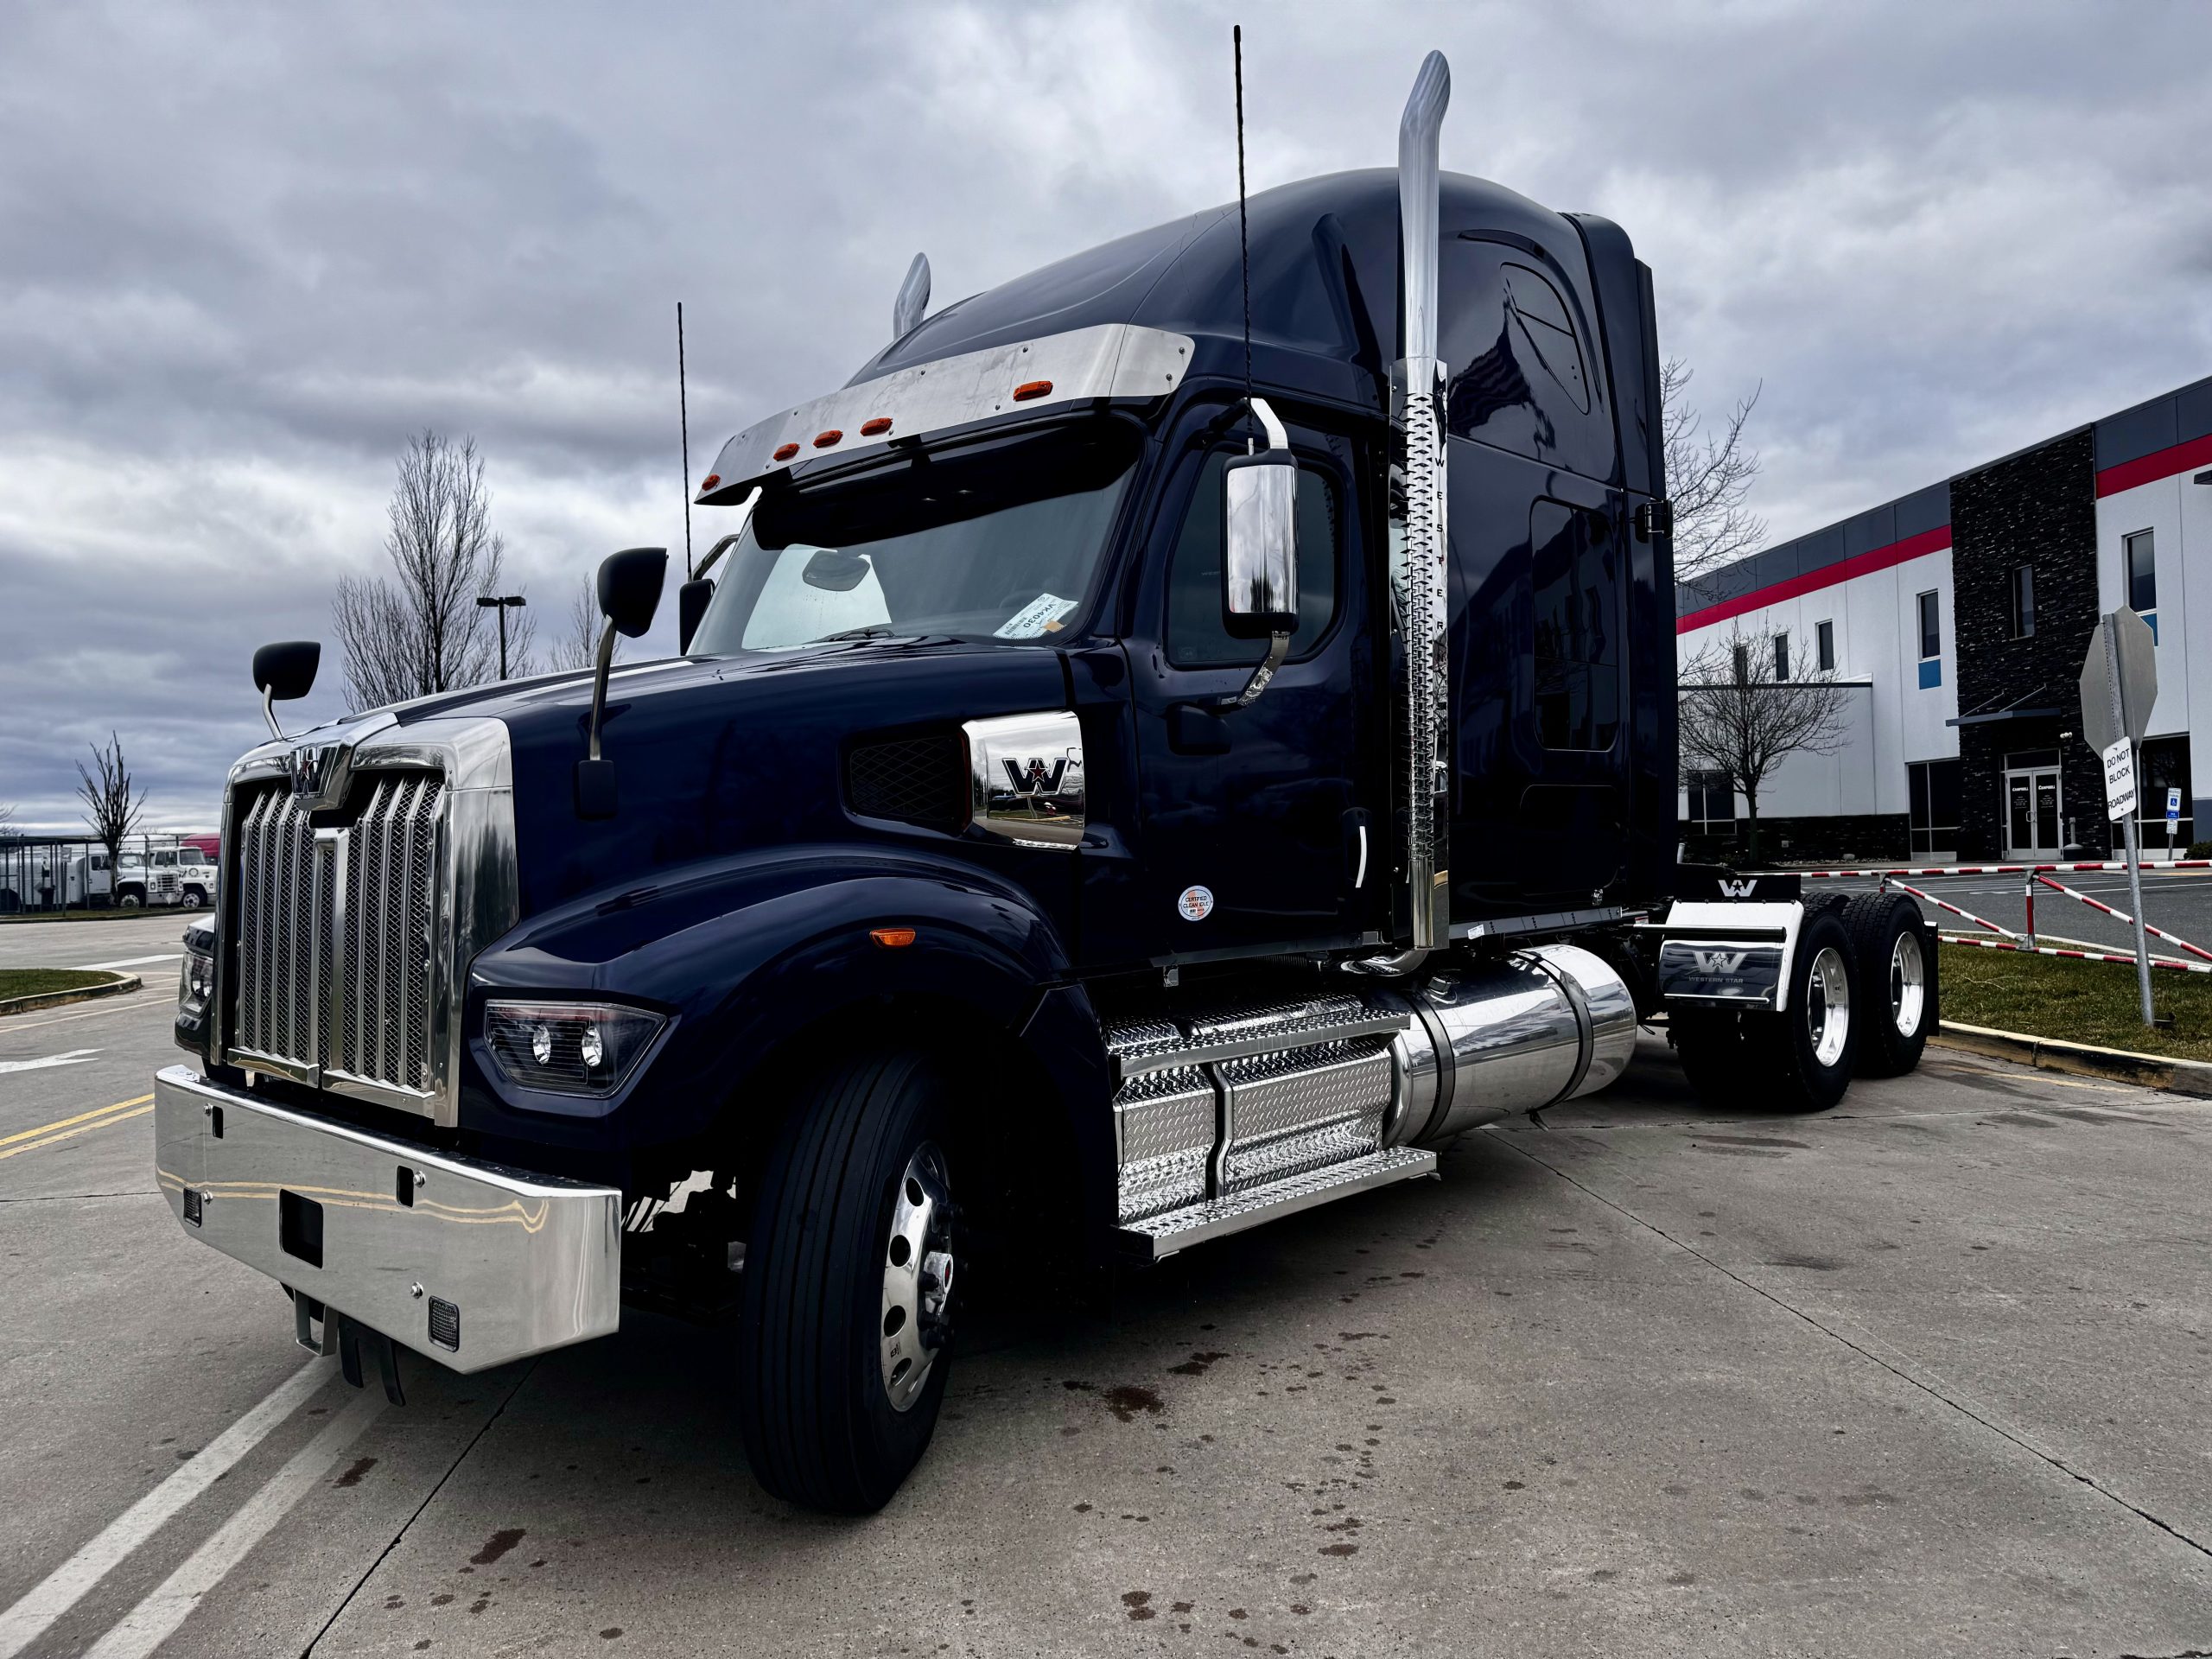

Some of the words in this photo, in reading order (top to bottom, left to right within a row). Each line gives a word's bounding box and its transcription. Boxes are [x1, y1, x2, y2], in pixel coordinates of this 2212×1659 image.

[1023, 603, 1056, 628] VK4030
[2107, 756, 2116, 769] DO
[2116, 747, 2130, 764] NOT
[2108, 766, 2131, 785] BLOCK
[2107, 789, 2135, 810] ROADWAY
